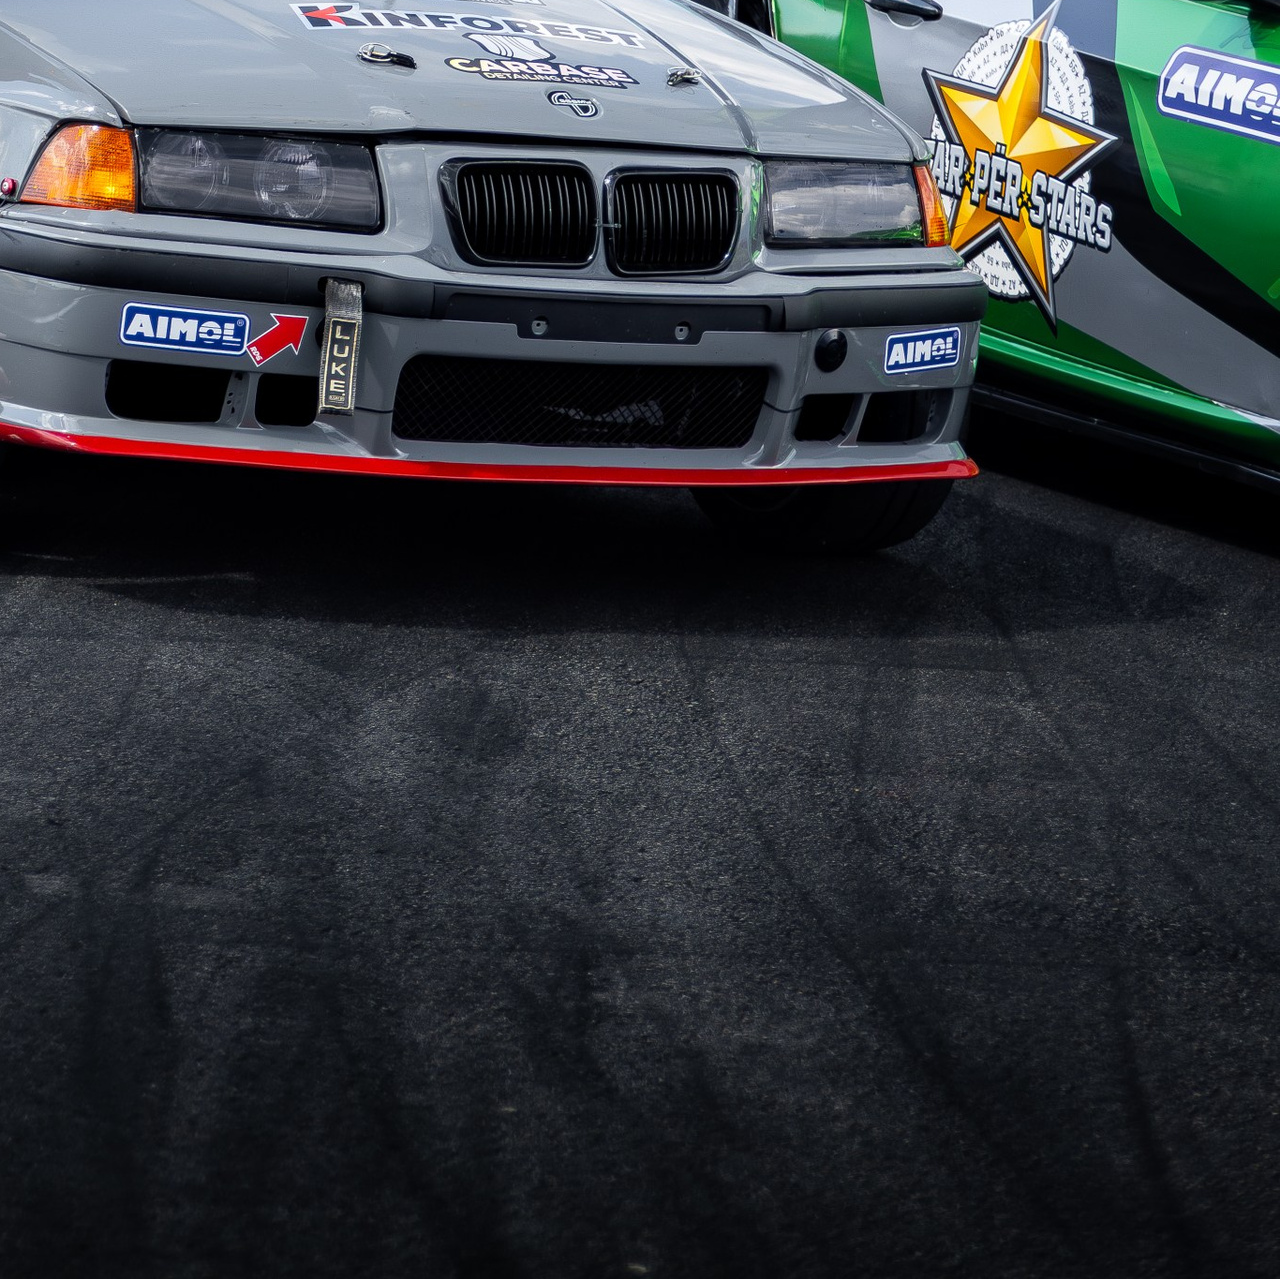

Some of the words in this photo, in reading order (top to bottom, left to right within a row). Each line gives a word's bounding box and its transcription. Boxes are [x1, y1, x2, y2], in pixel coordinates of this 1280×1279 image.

[301, 4, 642, 47] KINFOREST
[449, 58, 635, 83] CARBASE
[486, 71, 562, 83] DETAILING
[563, 75, 622, 88] CENTER
[970, 143, 1022, 216] PËR
[1029, 173, 1114, 250] STARS
[125, 313, 242, 347] AIMOL
[887, 336, 957, 366] AIMOL
